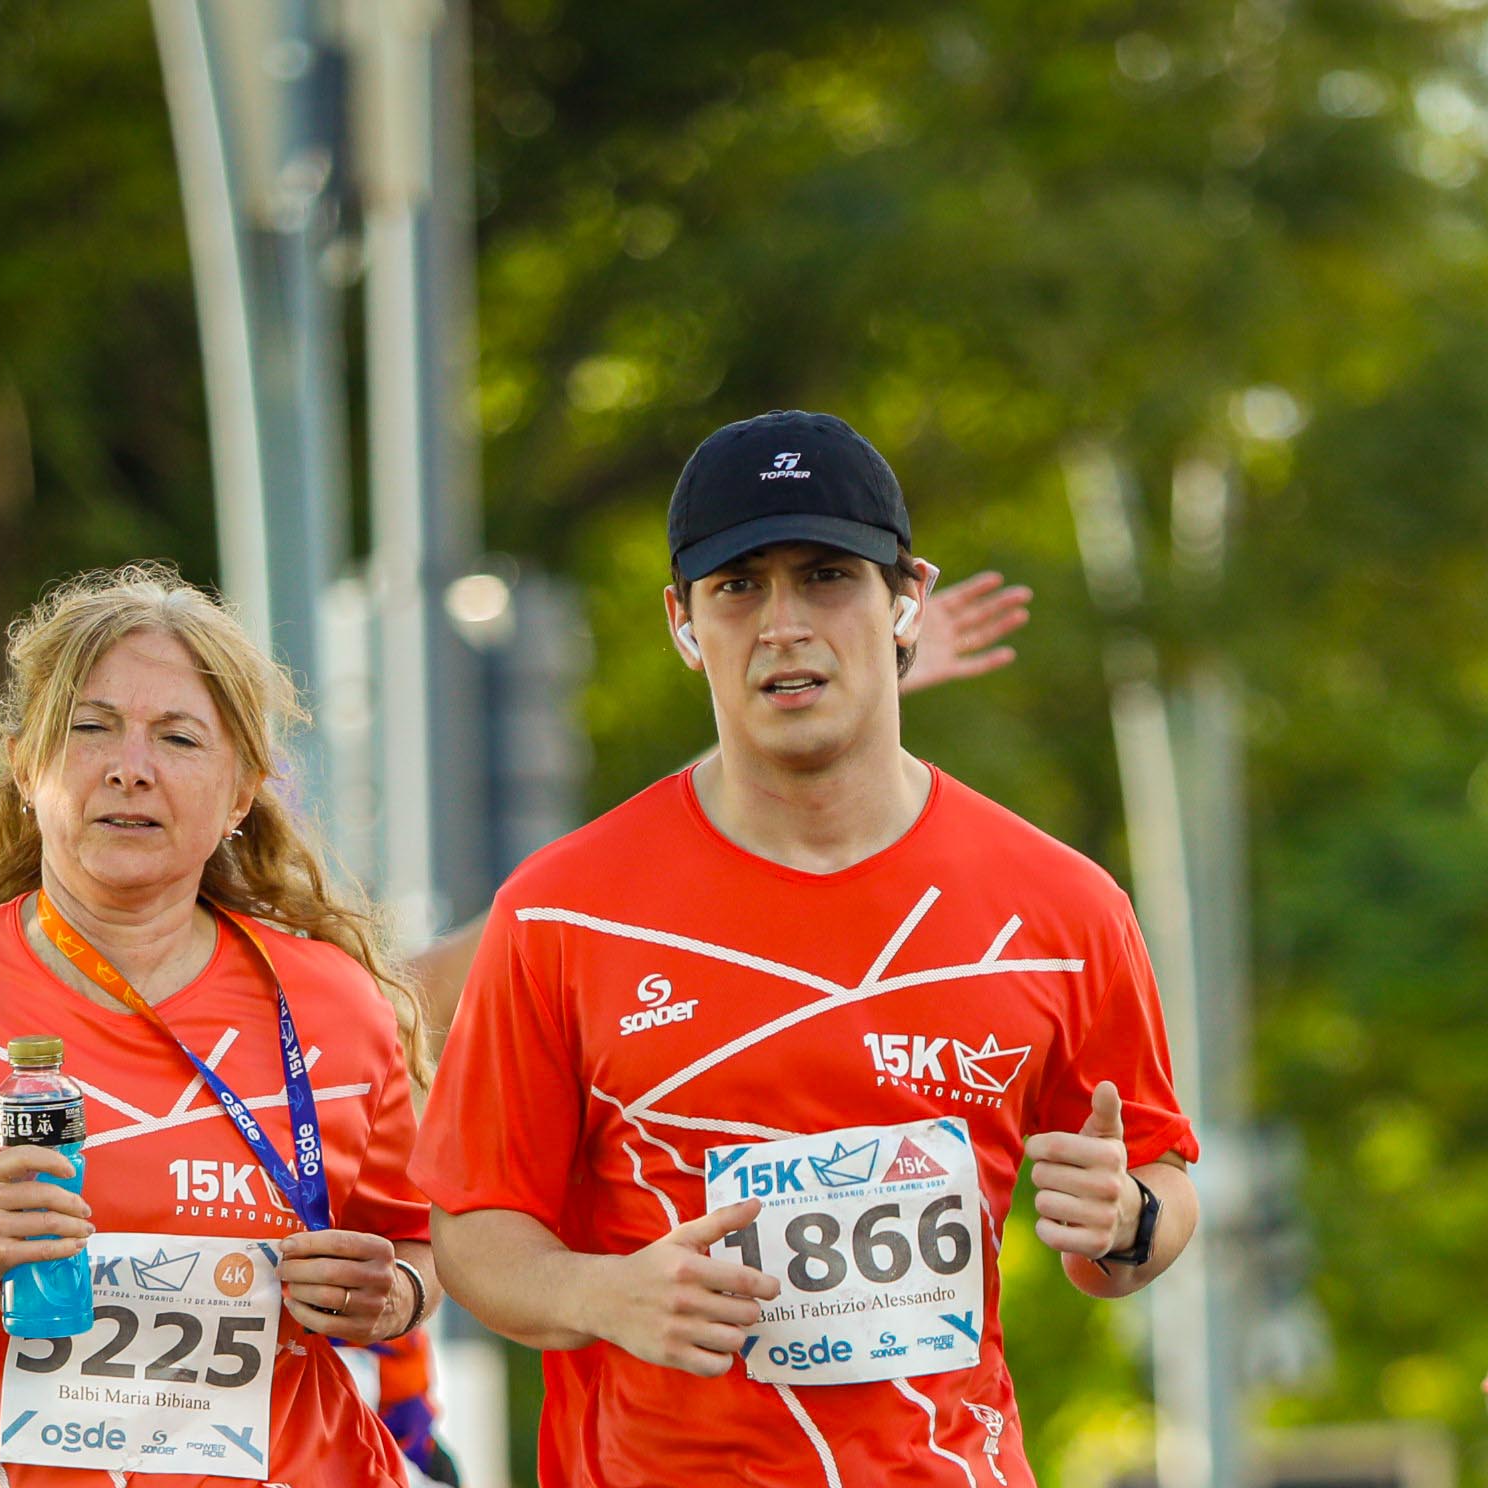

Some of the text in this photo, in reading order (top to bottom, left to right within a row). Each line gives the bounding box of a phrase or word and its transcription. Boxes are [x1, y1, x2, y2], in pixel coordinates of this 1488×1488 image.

[759, 470, 811, 480] TOPPER
[287, 1045, 304, 1079] 15K
[863, 1032, 950, 1082] 15K
[950, 1089, 1002, 1108] NORTE
[220, 1091, 261, 1142] osde
[296, 1123, 321, 1176] osde
[733, 1158, 805, 1198] 15K
[895, 1155, 931, 1176] 15K
[168, 1158, 257, 1205] 15K
[768, 1197, 796, 1208] NORTE
[827, 1189, 865, 1200] ROSARIO
[873, 1187, 884, 1196] 12
[886, 1184, 897, 1193] DE
[899, 1182, 923, 1192] ABRIL
[175, 1205, 256, 1221] PUERTO
[723, 1194, 972, 1293] 1866
[221, 1266, 247, 1285] 4K
[110, 1290, 130, 1299] 2026
[139, 1294, 174, 1303] ROSARIO
[207, 1299, 230, 1307] ABRIL
[233, 1300, 252, 1308] 2026
[756, 1285, 956, 1323] Balbi Fabrizio Alessandro
[769, 1335, 853, 1370] osde
[917, 1334, 955, 1346] POWER
[58, 1384, 211, 1410] Balbi Maria Bibiana
[41, 1420, 126, 1453] osde
[186, 1441, 226, 1452] POWER
